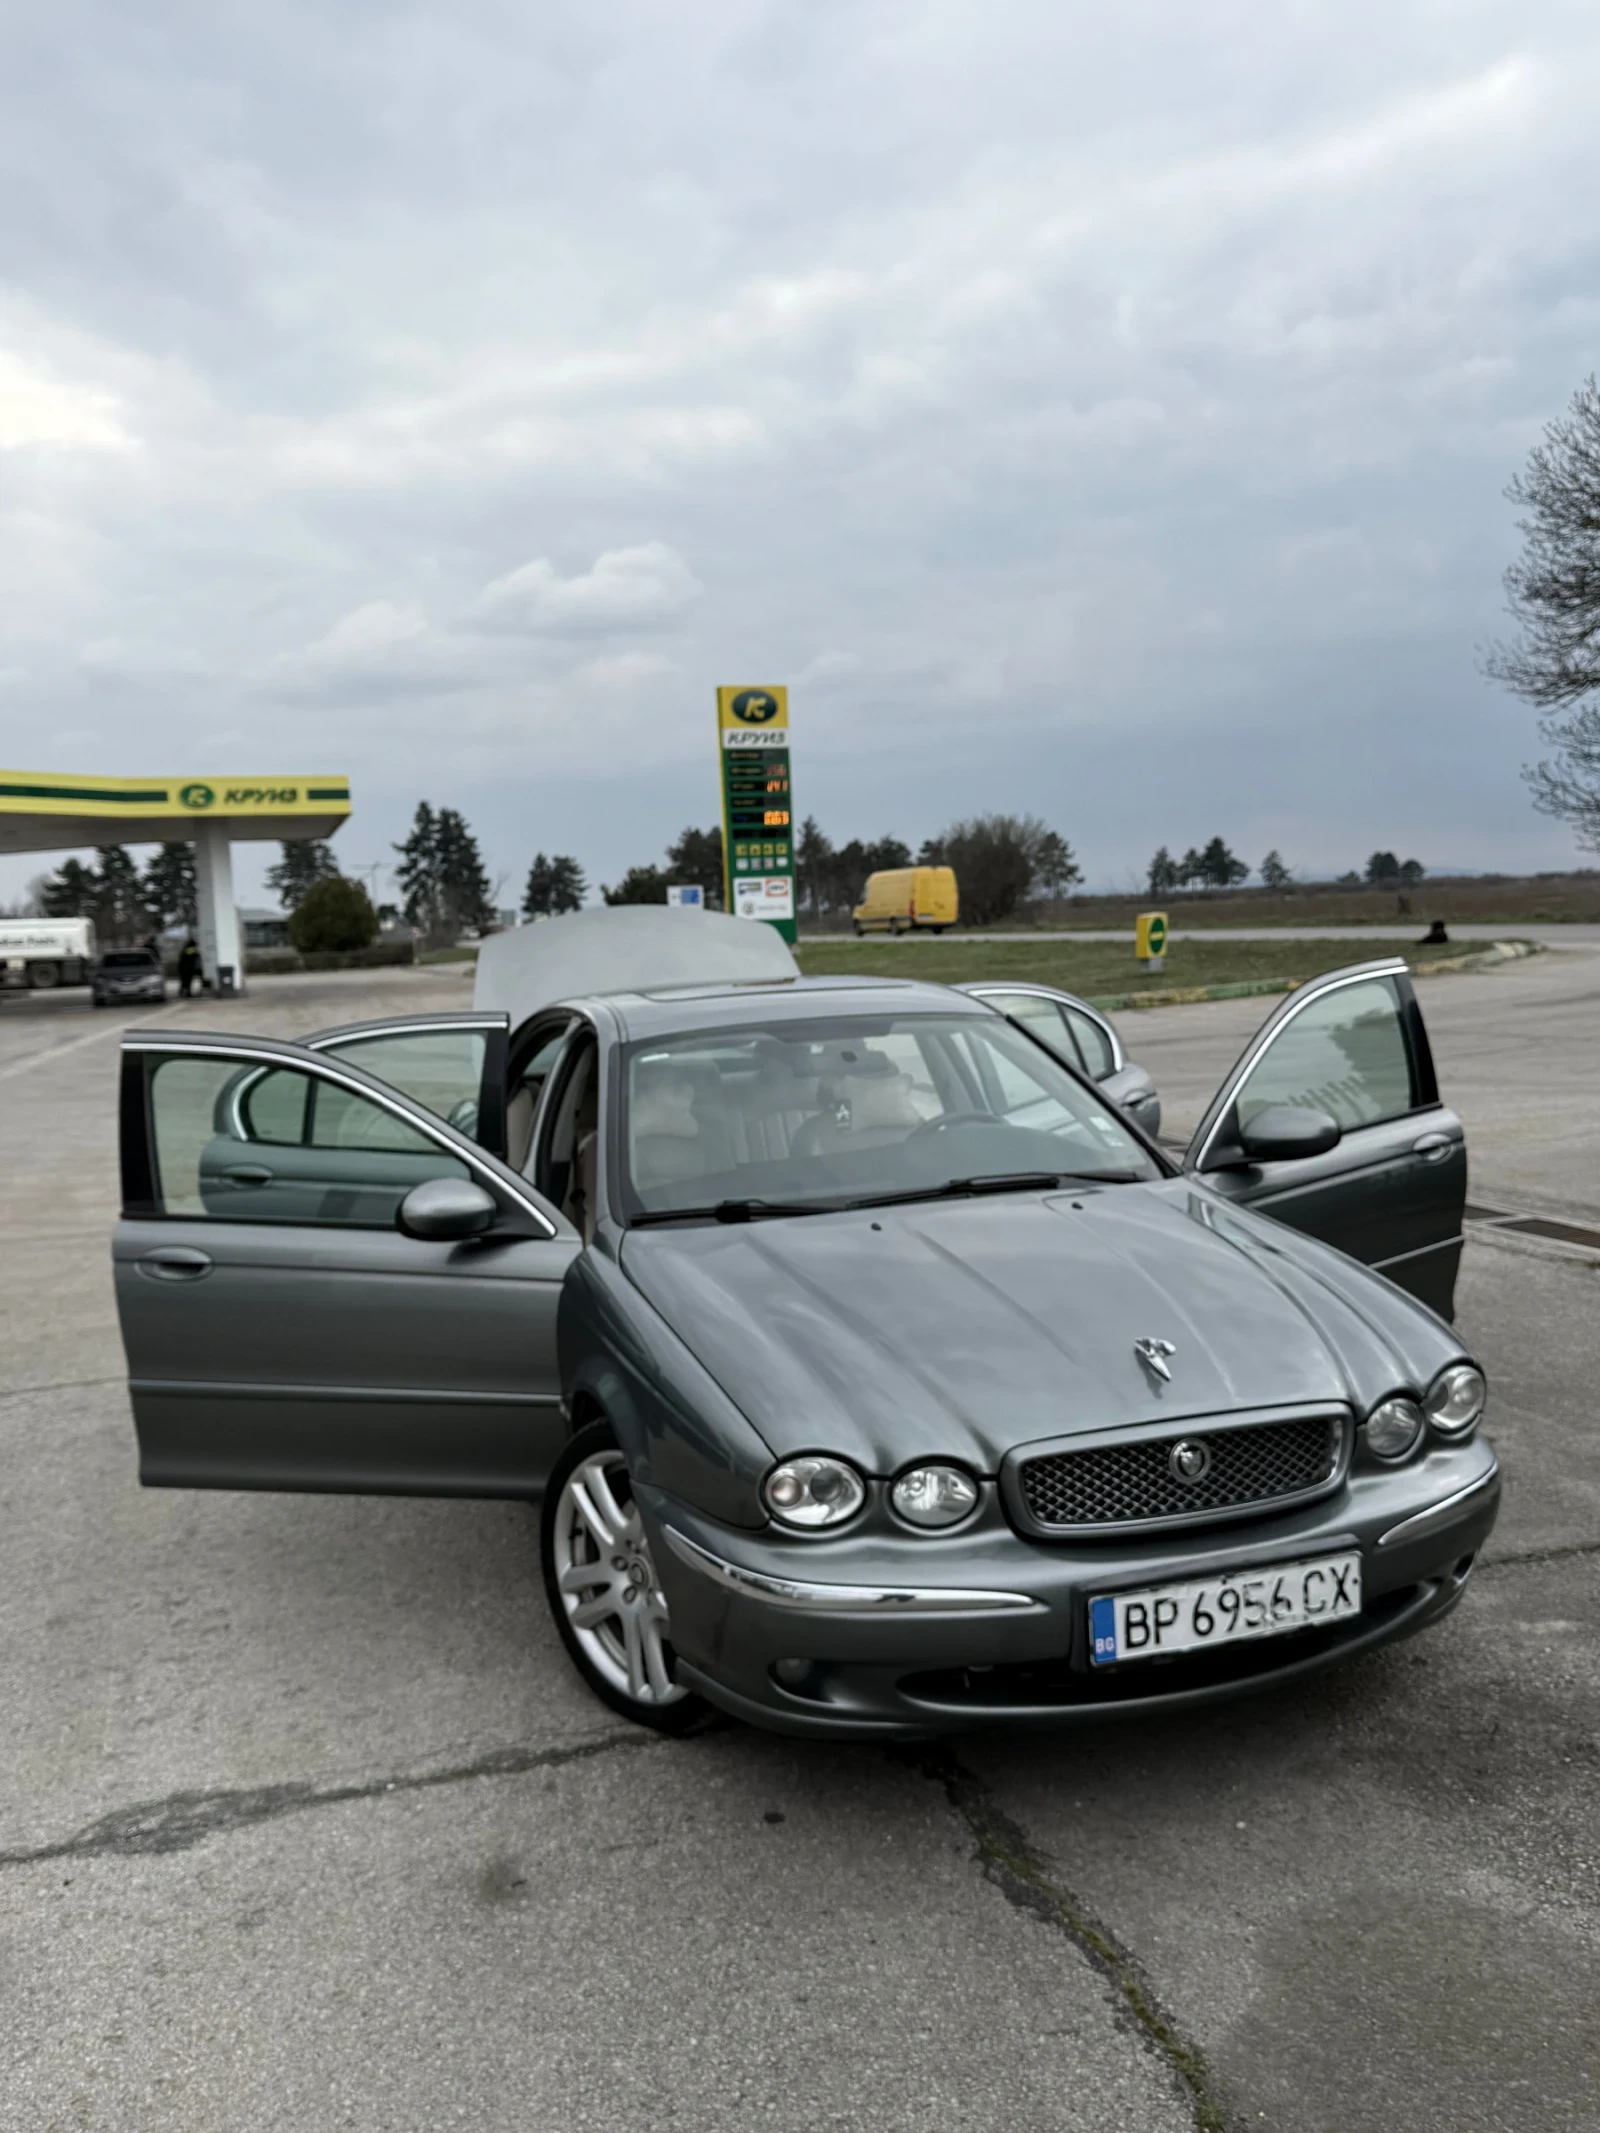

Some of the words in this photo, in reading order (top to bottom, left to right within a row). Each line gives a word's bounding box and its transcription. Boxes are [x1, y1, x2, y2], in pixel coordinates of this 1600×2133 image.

[224, 788, 298, 803] КРУИЗ
[1191, 1577, 1292, 1636] 6956
[1095, 1636, 1115, 1654] BG
